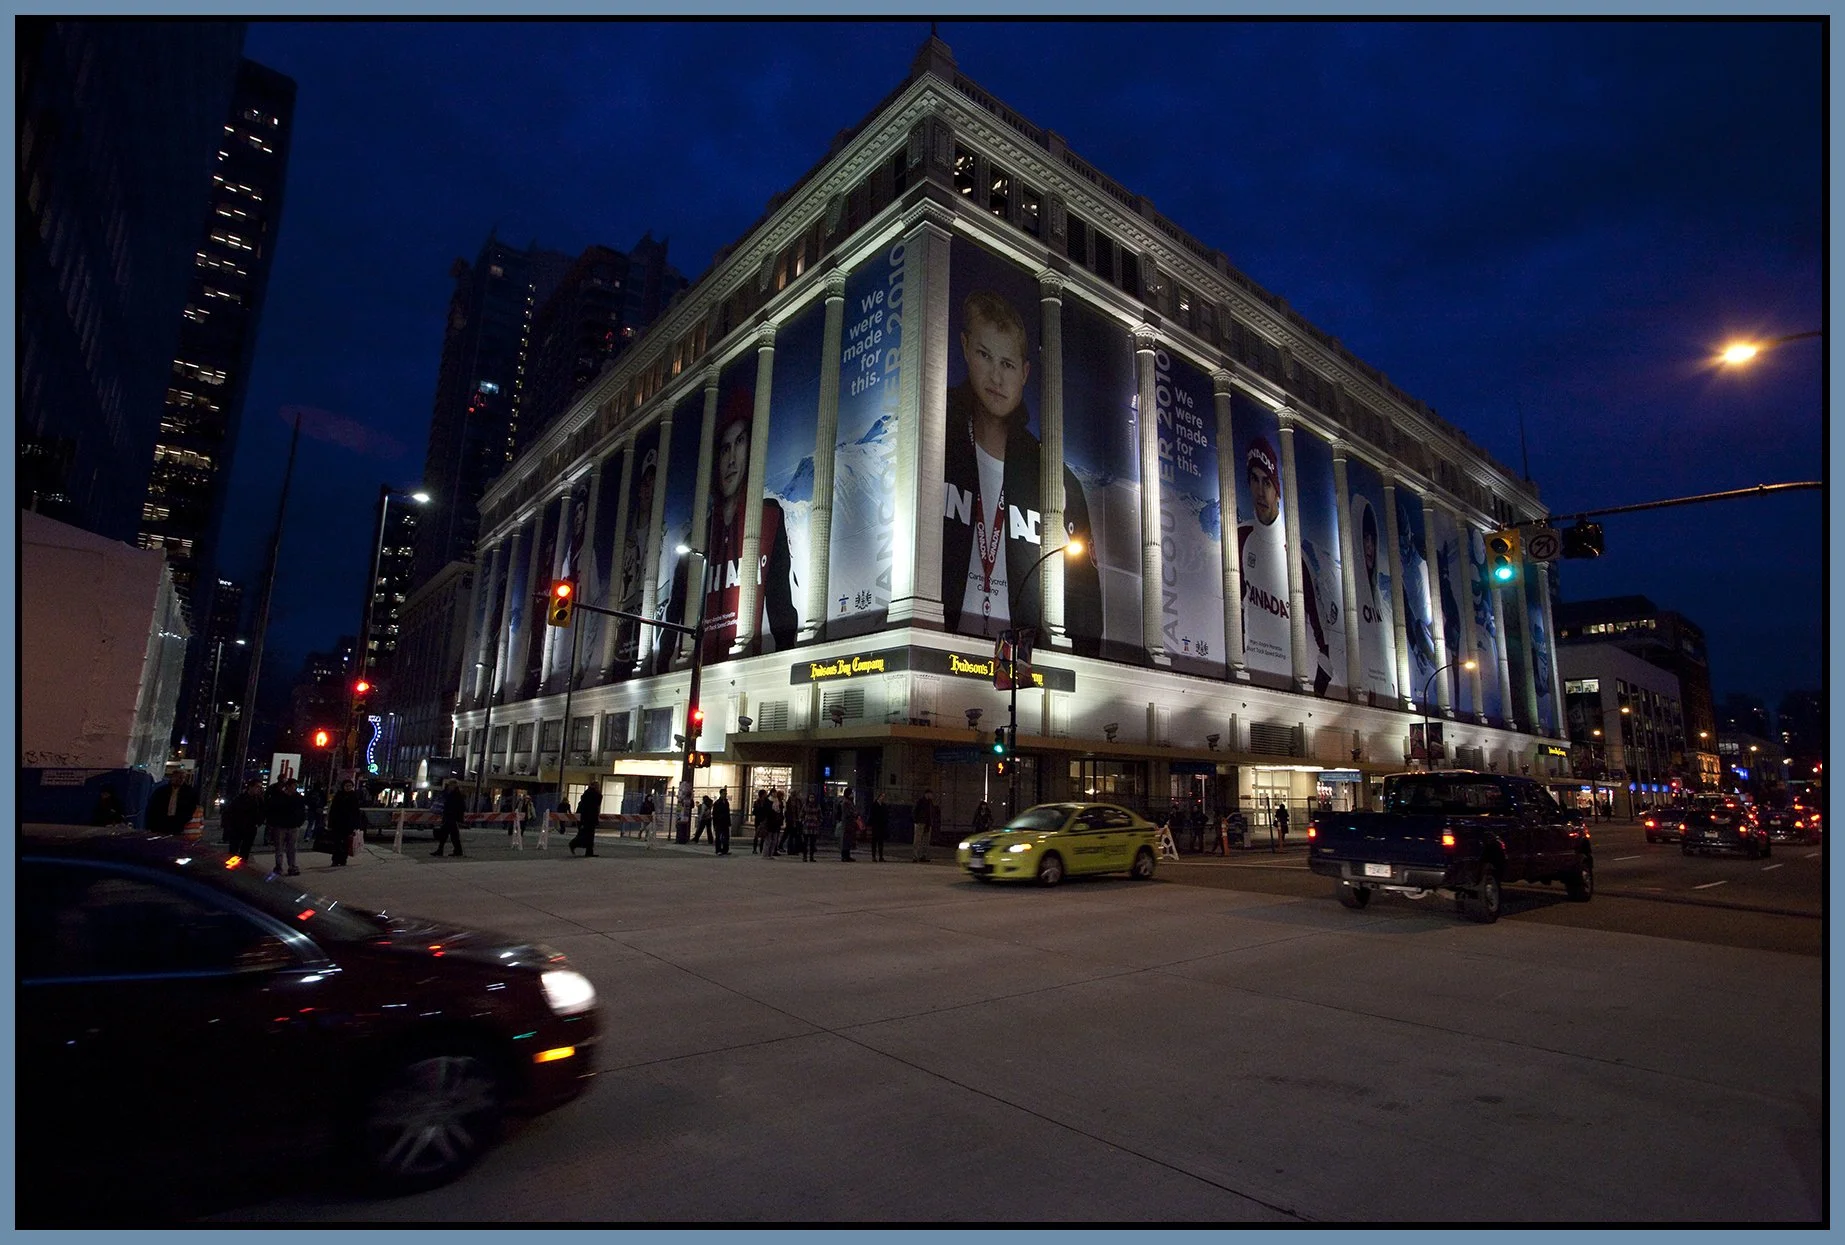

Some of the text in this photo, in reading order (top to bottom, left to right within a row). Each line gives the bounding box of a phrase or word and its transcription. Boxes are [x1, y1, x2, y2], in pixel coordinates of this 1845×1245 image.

[886, 240, 905, 335] 2010
[861, 289, 884, 314] We
[849, 309, 883, 340] were
[843, 329, 882, 363] made
[860, 348, 881, 372] for
[851, 371, 881, 397] this.
[1155, 349, 1173, 430] 2010
[1174, 386, 1194, 408] We
[1175, 406, 1203, 429] were
[1176, 423, 1207, 447] made
[1176, 437, 1193, 457] for
[1177, 455, 1201, 478] this.
[968, 571, 1007, 587] Carte ycroft
[836, 659, 852, 677] Bay
[852, 656, 885, 673] Company
[949, 654, 988, 675] Hudson's
